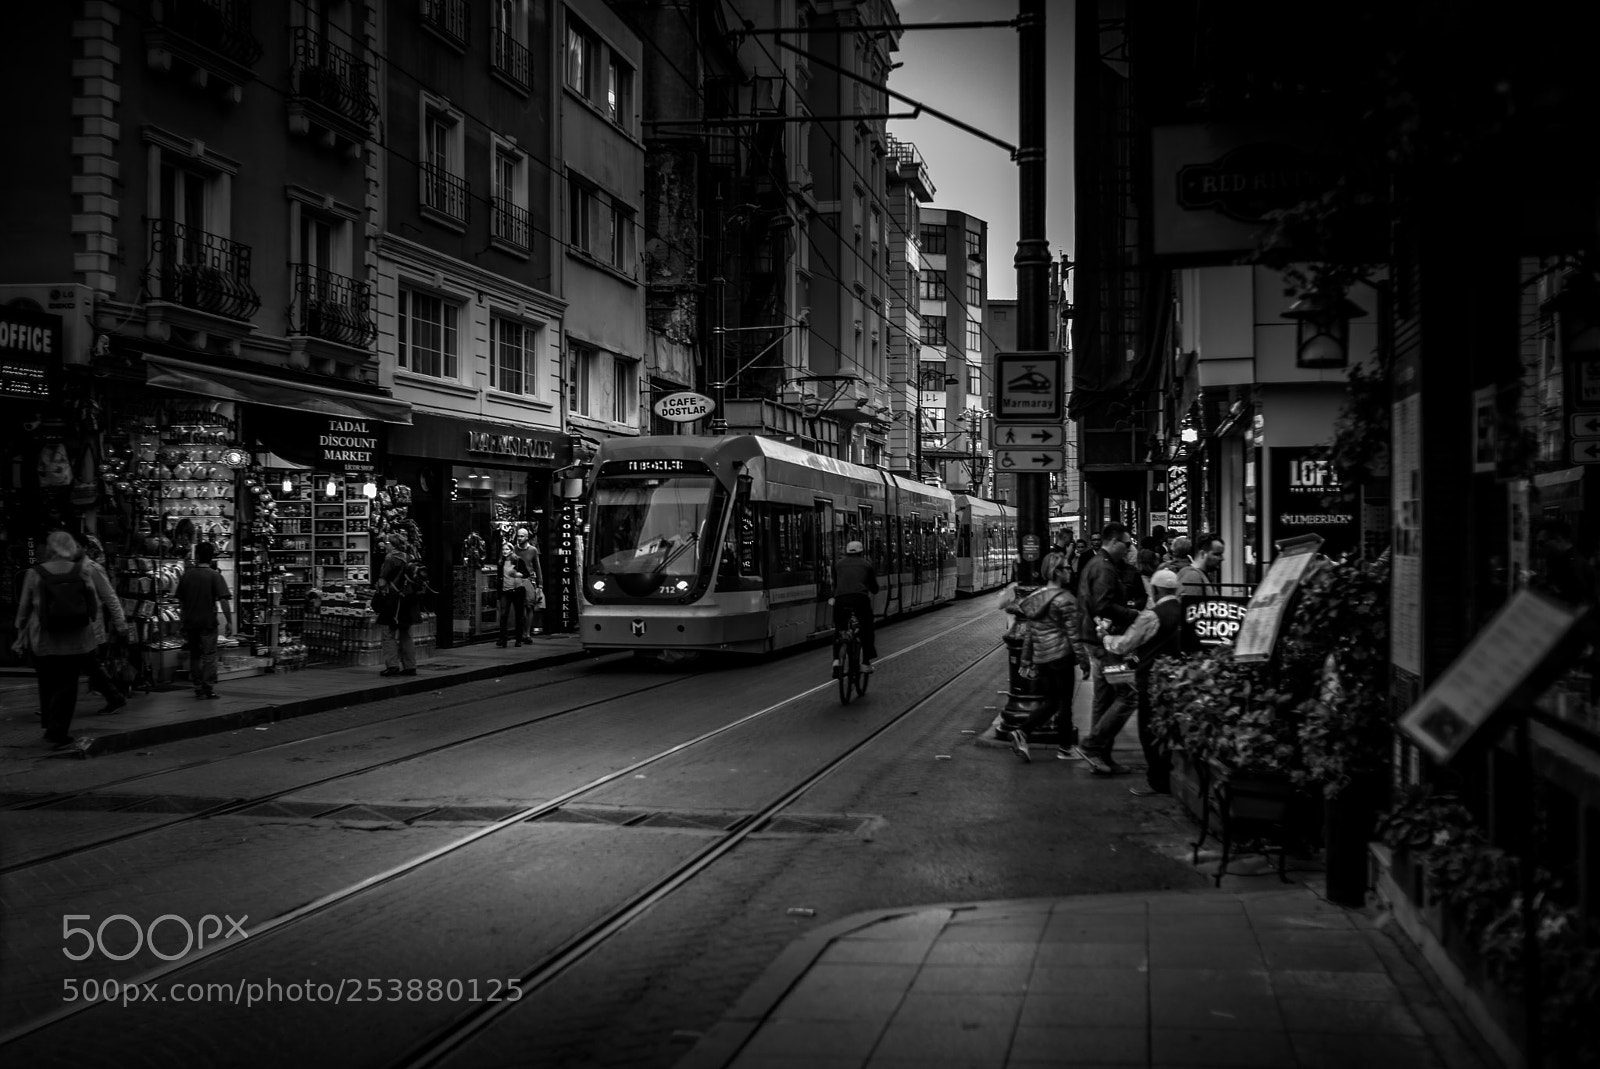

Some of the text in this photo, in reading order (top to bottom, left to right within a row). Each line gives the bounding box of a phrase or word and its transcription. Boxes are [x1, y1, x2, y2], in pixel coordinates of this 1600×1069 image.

[1202, 173, 1246, 193] RED
[0, 320, 52, 354] OFFICE
[669, 397, 697, 407] CAFE
[1003, 399, 1053, 409] Marmaray
[662, 405, 706, 417] DOSTLAR
[328, 420, 370, 433] TADAL
[323, 449, 372, 462] MARKET
[1289, 514, 1348, 525] LUMBERJACK
[660, 586, 676, 594] 712
[1194, 620, 1240, 637] SHOP
